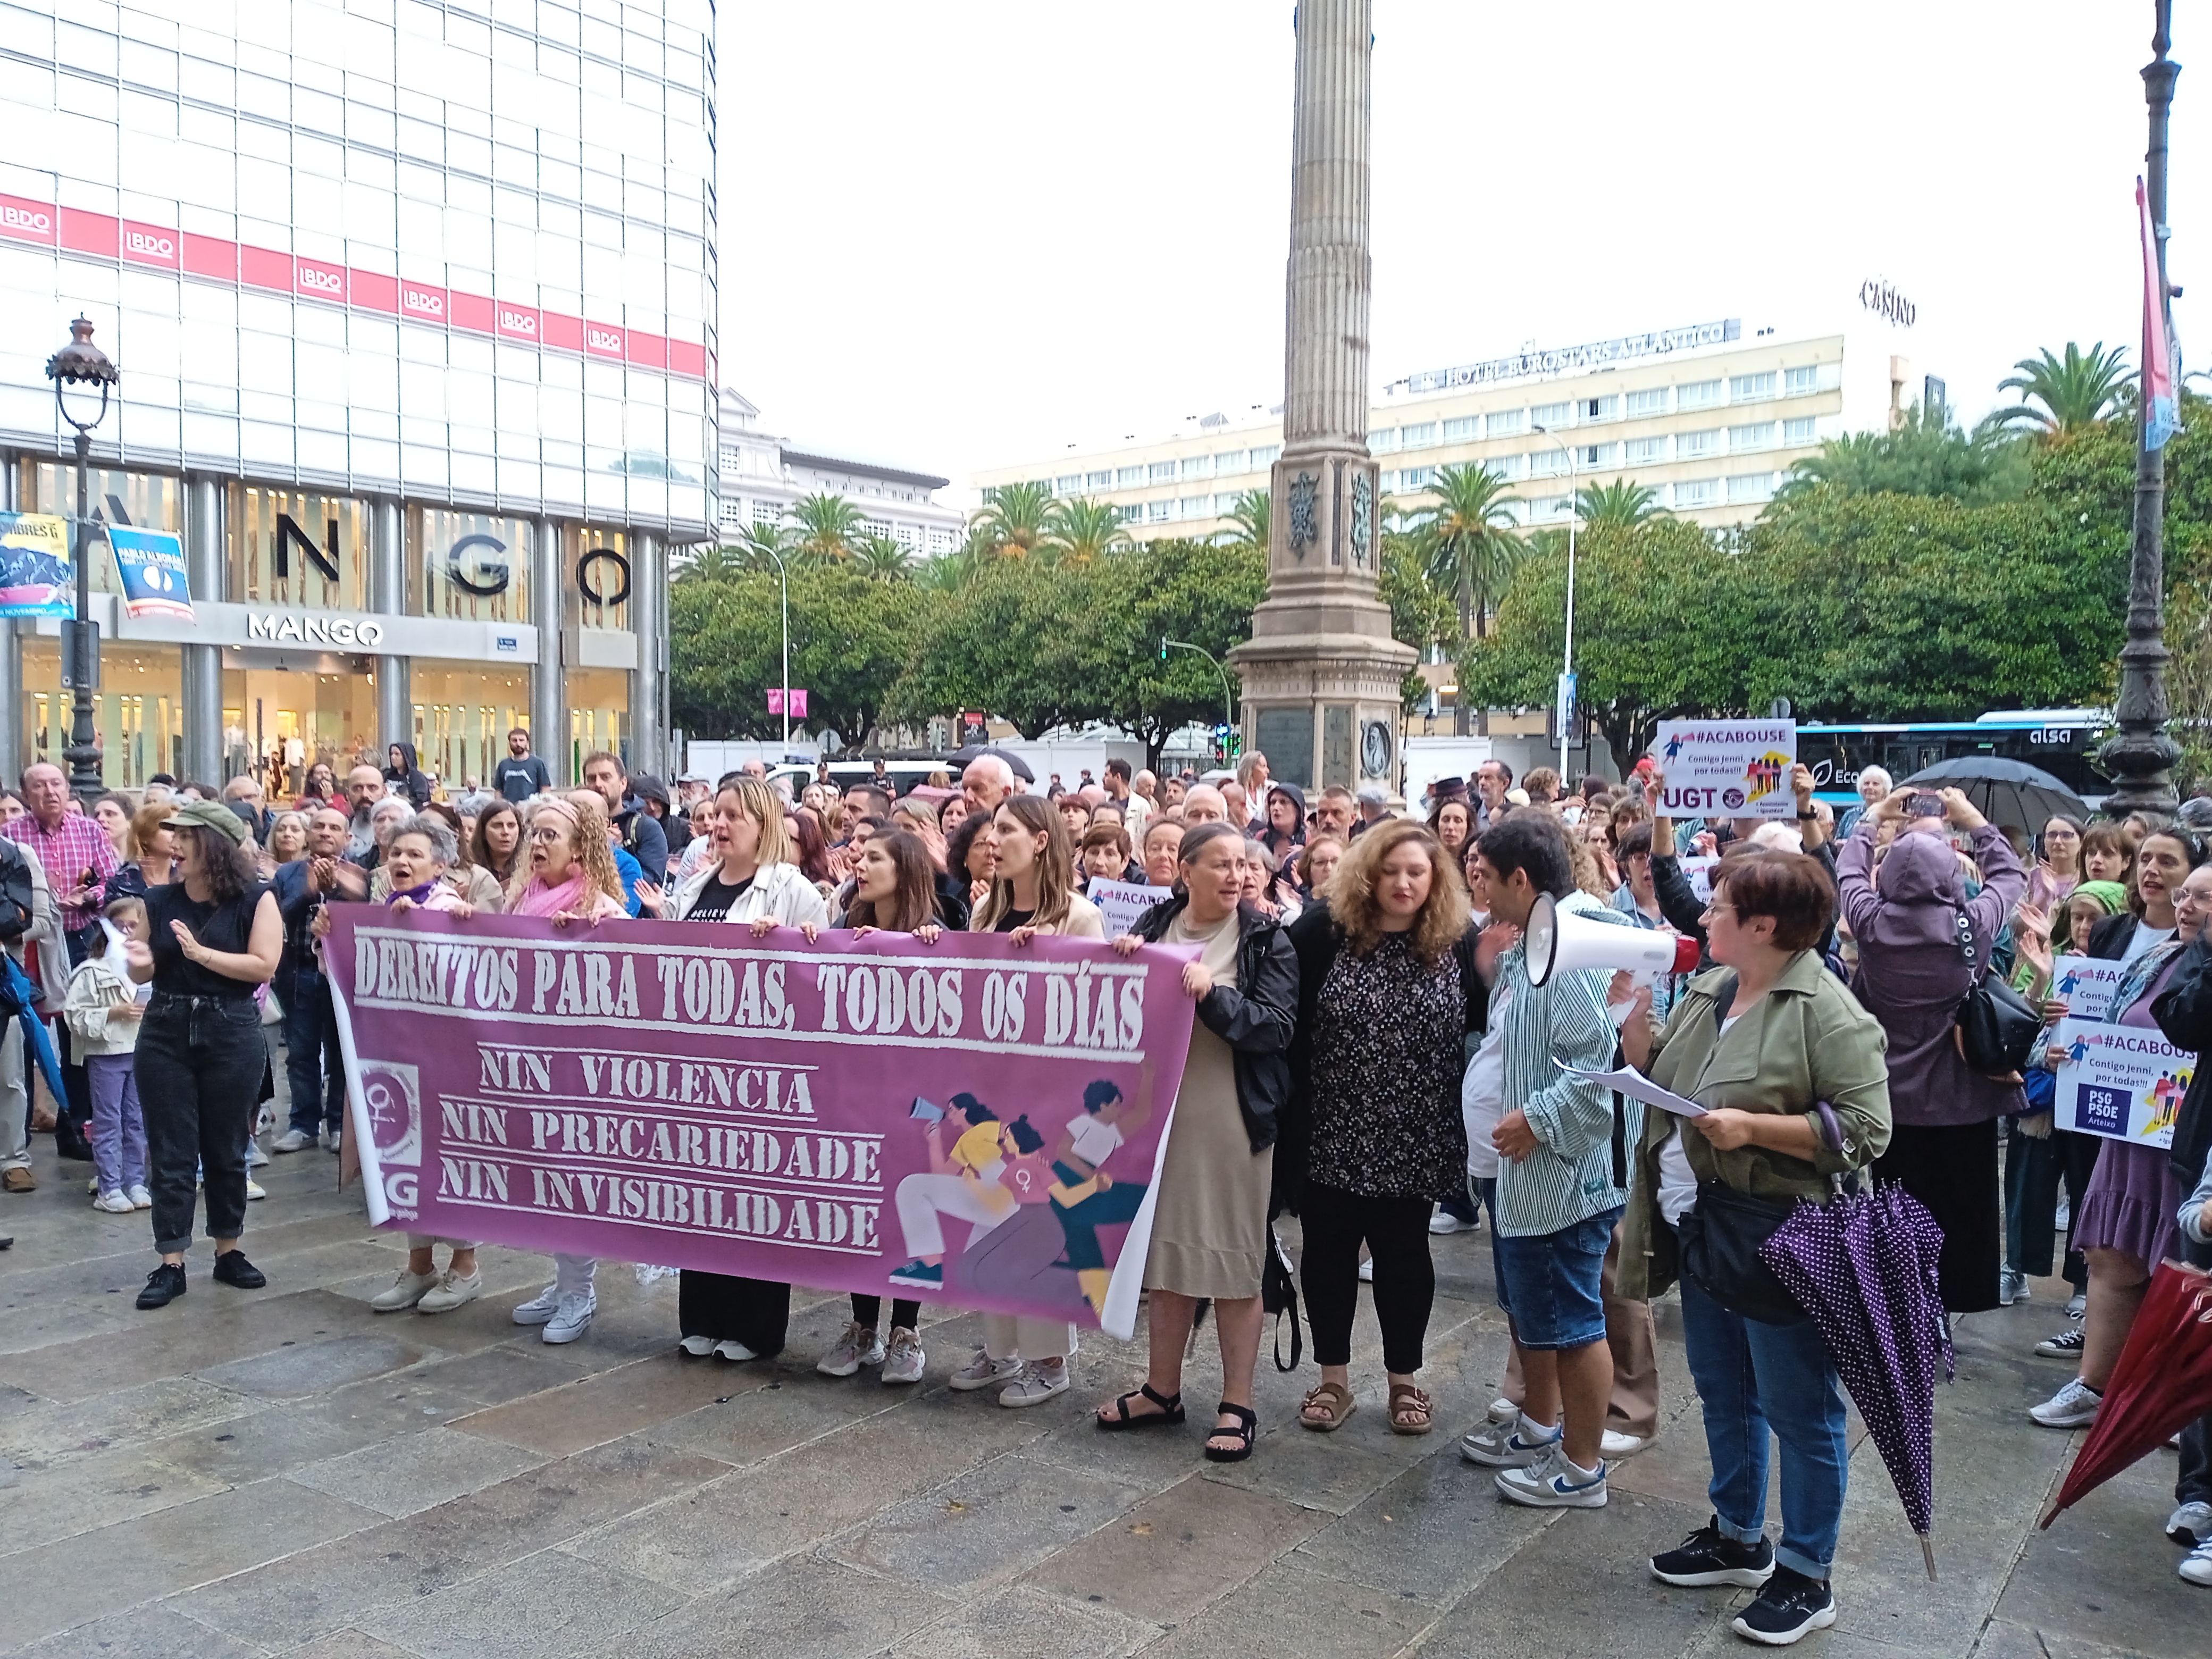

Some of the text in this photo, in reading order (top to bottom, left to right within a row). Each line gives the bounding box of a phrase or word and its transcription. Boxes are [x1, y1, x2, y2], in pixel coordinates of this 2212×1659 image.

[5, 207, 49, 230] BDO
[132, 232, 173, 254] BDO
[305, 269, 342, 290] BDO
[409, 290, 443, 311] BDO
[505, 311, 535, 330] BDO
[592, 329, 621, 347] BDO
[1445, 358, 1504, 387] HOTEL
[1507, 341, 1612, 375] EUROSTARS
[247, 612, 383, 646] MANGO
[1696, 728, 1787, 744] #ACABOUSE
[2030, 728, 2071, 744] alsa
[1688, 754, 1720, 765] Contigo
[1694, 768, 1708, 776] por
[1836, 769, 1859, 784] Eco
[1664, 787, 1717, 809] UGT
[1115, 890, 1166, 906] #ACABO
[691, 909, 727, 918] BELIEV
[1108, 911, 1134, 921] Contigo
[354, 937, 1146, 1051] DEREITOS PARA TODAS, TODOS OS DÍAS
[2087, 1004, 2102, 1013] por
[2104, 1034, 2196, 1060] #ACABOUS
[2089, 1058, 2125, 1071] Contigo
[478, 1049, 815, 1114] NIN VIOLENCIA
[2095, 1074, 2148, 1088] por todas!!!
[2089, 1090, 2113, 1105] PSG
[2088, 1103, 2119, 1119] PSOE
[2088, 1117, 2116, 1128] Arteixo
[439, 1099, 508, 1146] NIN
[532, 1111, 881, 1184] PRECARIEDADE
[439, 1156, 881, 1248] NIN INVISIBILIDADE
